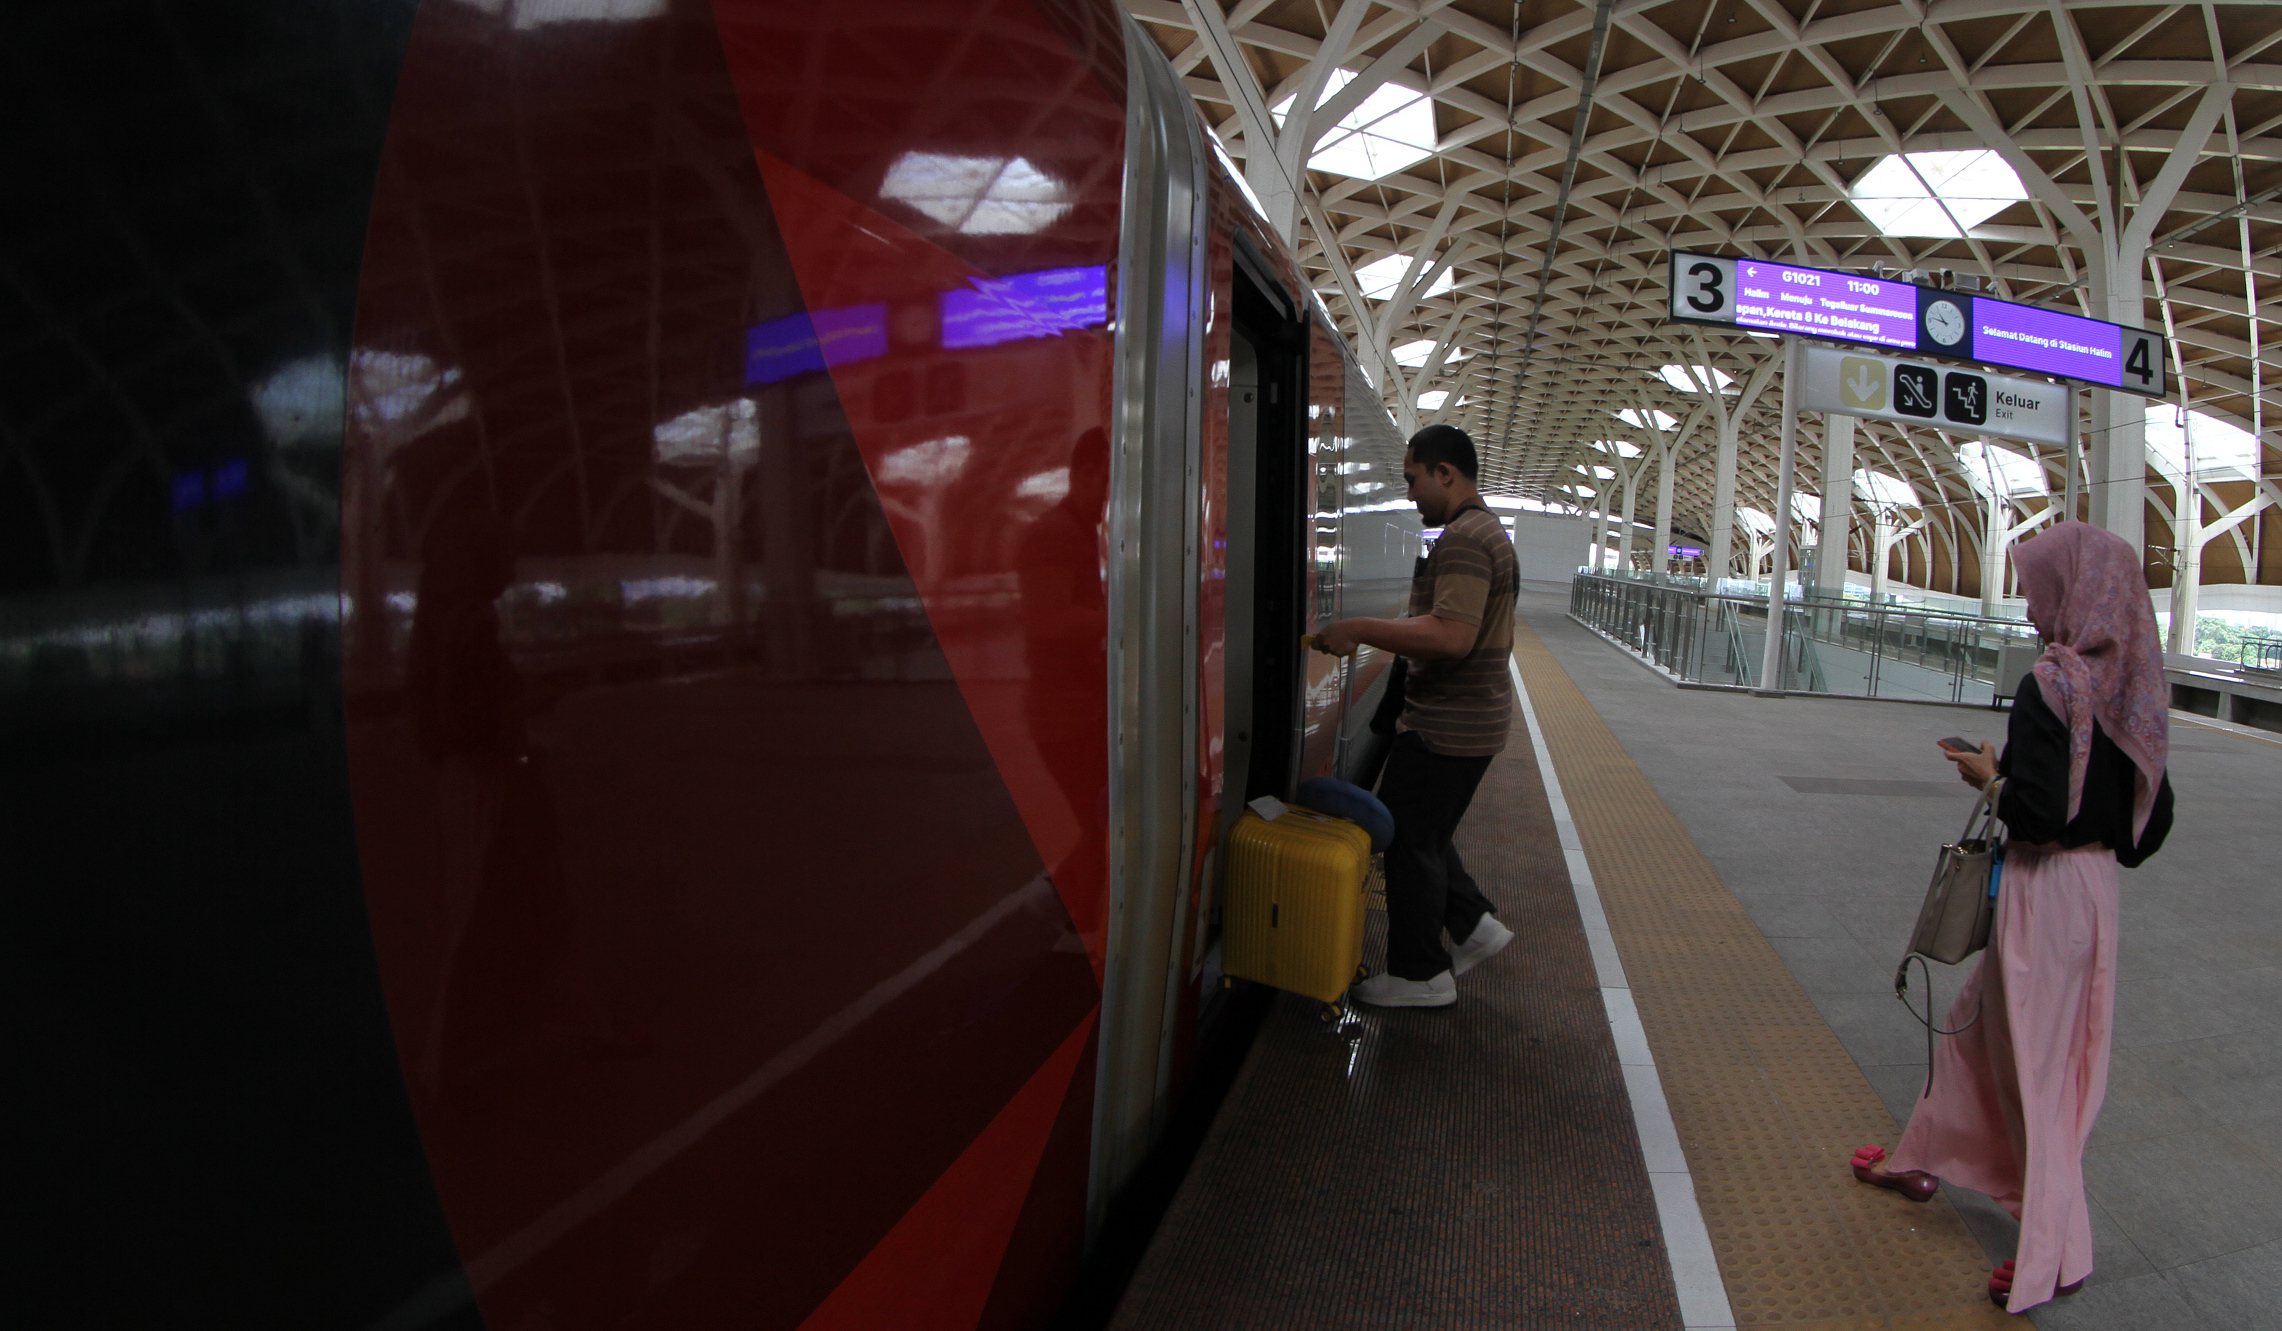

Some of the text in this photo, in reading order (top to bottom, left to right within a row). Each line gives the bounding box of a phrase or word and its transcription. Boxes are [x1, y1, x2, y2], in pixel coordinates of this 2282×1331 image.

[1686, 262, 1724, 313] 3
[1782, 271, 1880, 295] G1021 11:00
[1744, 287, 1770, 299] Halim
[1781, 292, 1813, 305] Menuju
[1805, 311, 1813, 322] 8
[1814, 313, 1829, 324] Ke
[1830, 315, 1880, 334] Belakang
[1982, 326, 2112, 359] Selamat Datang di Stasiun Halim
[2125, 337, 2154, 385] 4
[1996, 391, 2040, 410] Keluar
[1995, 408, 2013, 420] Exit
